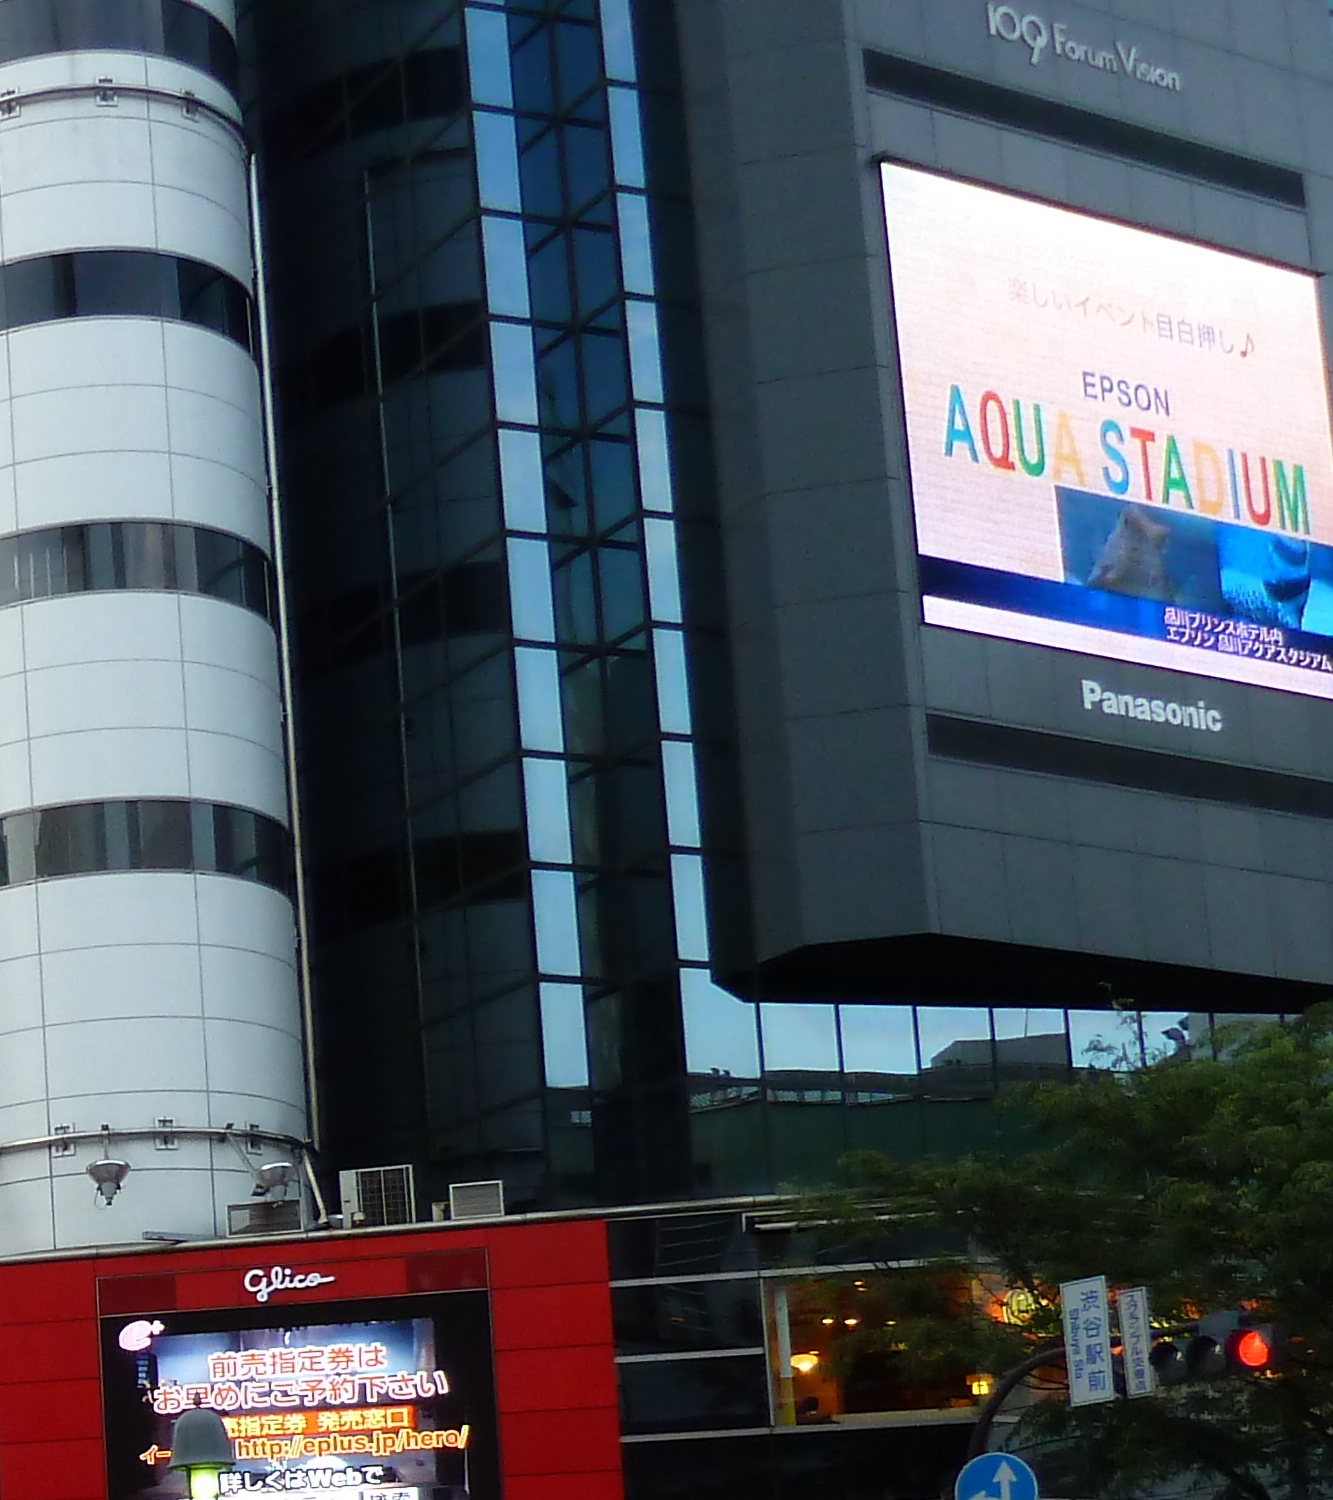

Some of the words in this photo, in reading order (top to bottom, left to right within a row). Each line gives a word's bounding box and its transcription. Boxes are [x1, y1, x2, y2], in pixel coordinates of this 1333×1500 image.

[986, 2, 1048, 66] 109
[1052, 23, 1119, 74] Forum
[1116, 41, 1182, 92] Vision
[1082, 370, 1171, 417] EPSON
[943, 383, 1086, 489] AQUA
[1099, 418, 1311, 537] STADIUM
[1081, 679, 1223, 733] Panasonic
[244, 1266, 336, 1302] Glico
[208, 1342, 388, 1381] 前売指定券は
[1080, 1289, 1107, 1392] 渋谷駅前
